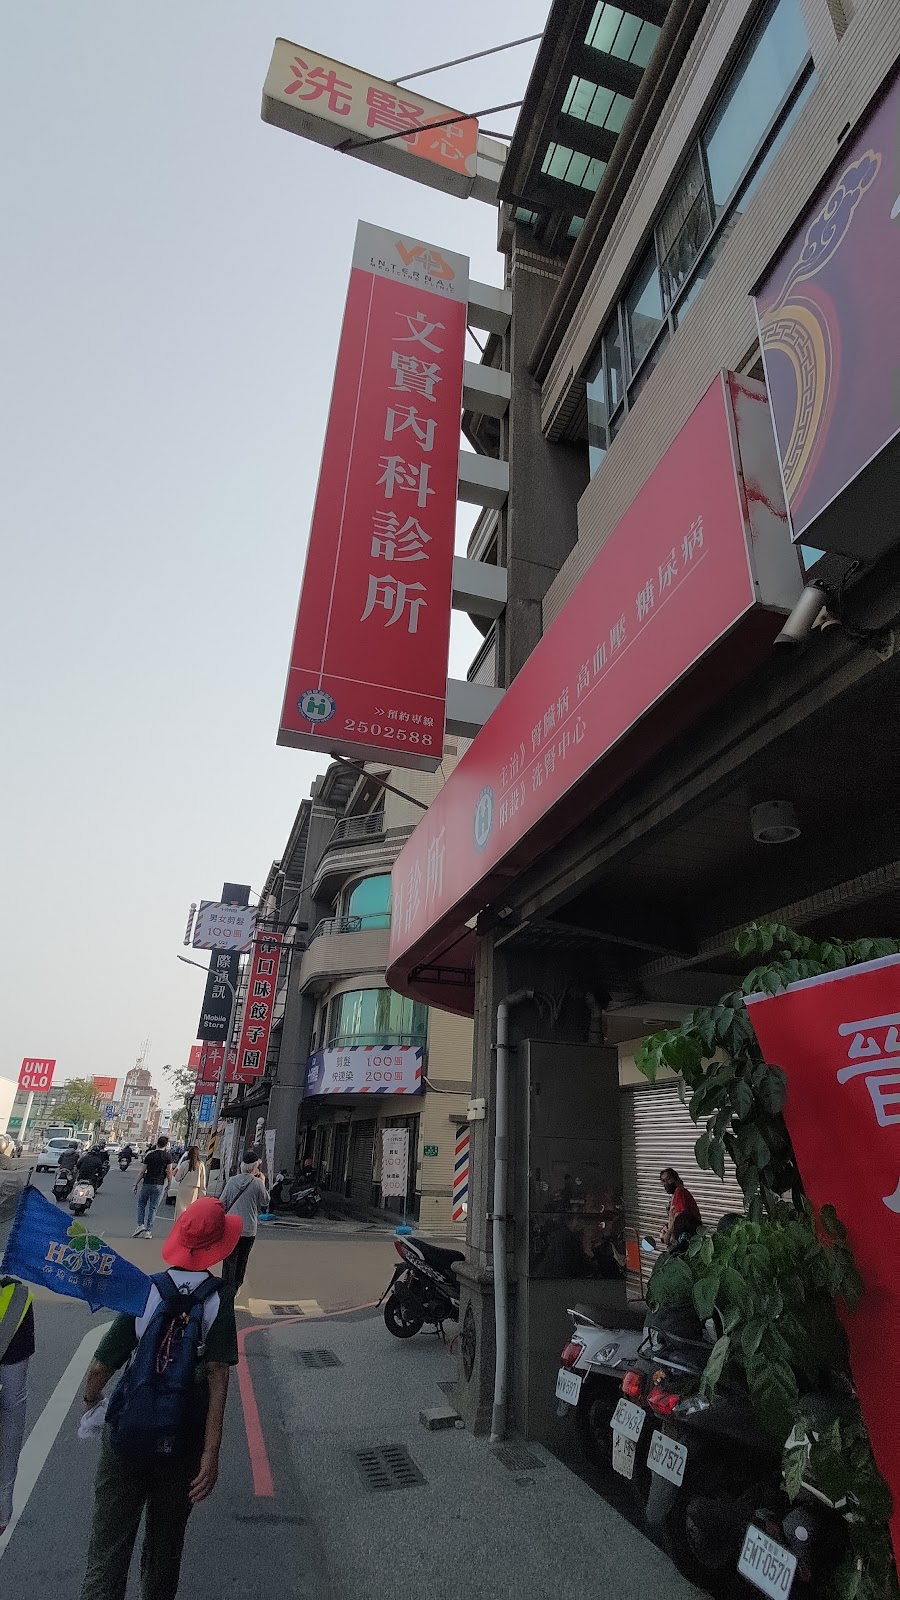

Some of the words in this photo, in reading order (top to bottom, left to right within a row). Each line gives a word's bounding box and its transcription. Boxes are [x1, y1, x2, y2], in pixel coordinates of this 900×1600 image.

[370, 257, 455, 290] INTERNAL
[360, 310, 446, 634] 文賢內科診所
[576, 613, 626, 698] 高血壓
[636, 514, 704, 622] 糖尿病
[343, 718, 433, 747] 2502588
[387, 708, 434, 727] 預約專線
[531, 716, 587, 792] 洗腎中心
[211, 954, 232, 999] 際通訊
[203, 1013, 227, 1022] Mobile
[203, 1021, 224, 1029] Store
[21, 1074, 48, 1089] QLO
[24, 1061, 50, 1074] UNI
[44, 1240, 117, 1276] HOPE
